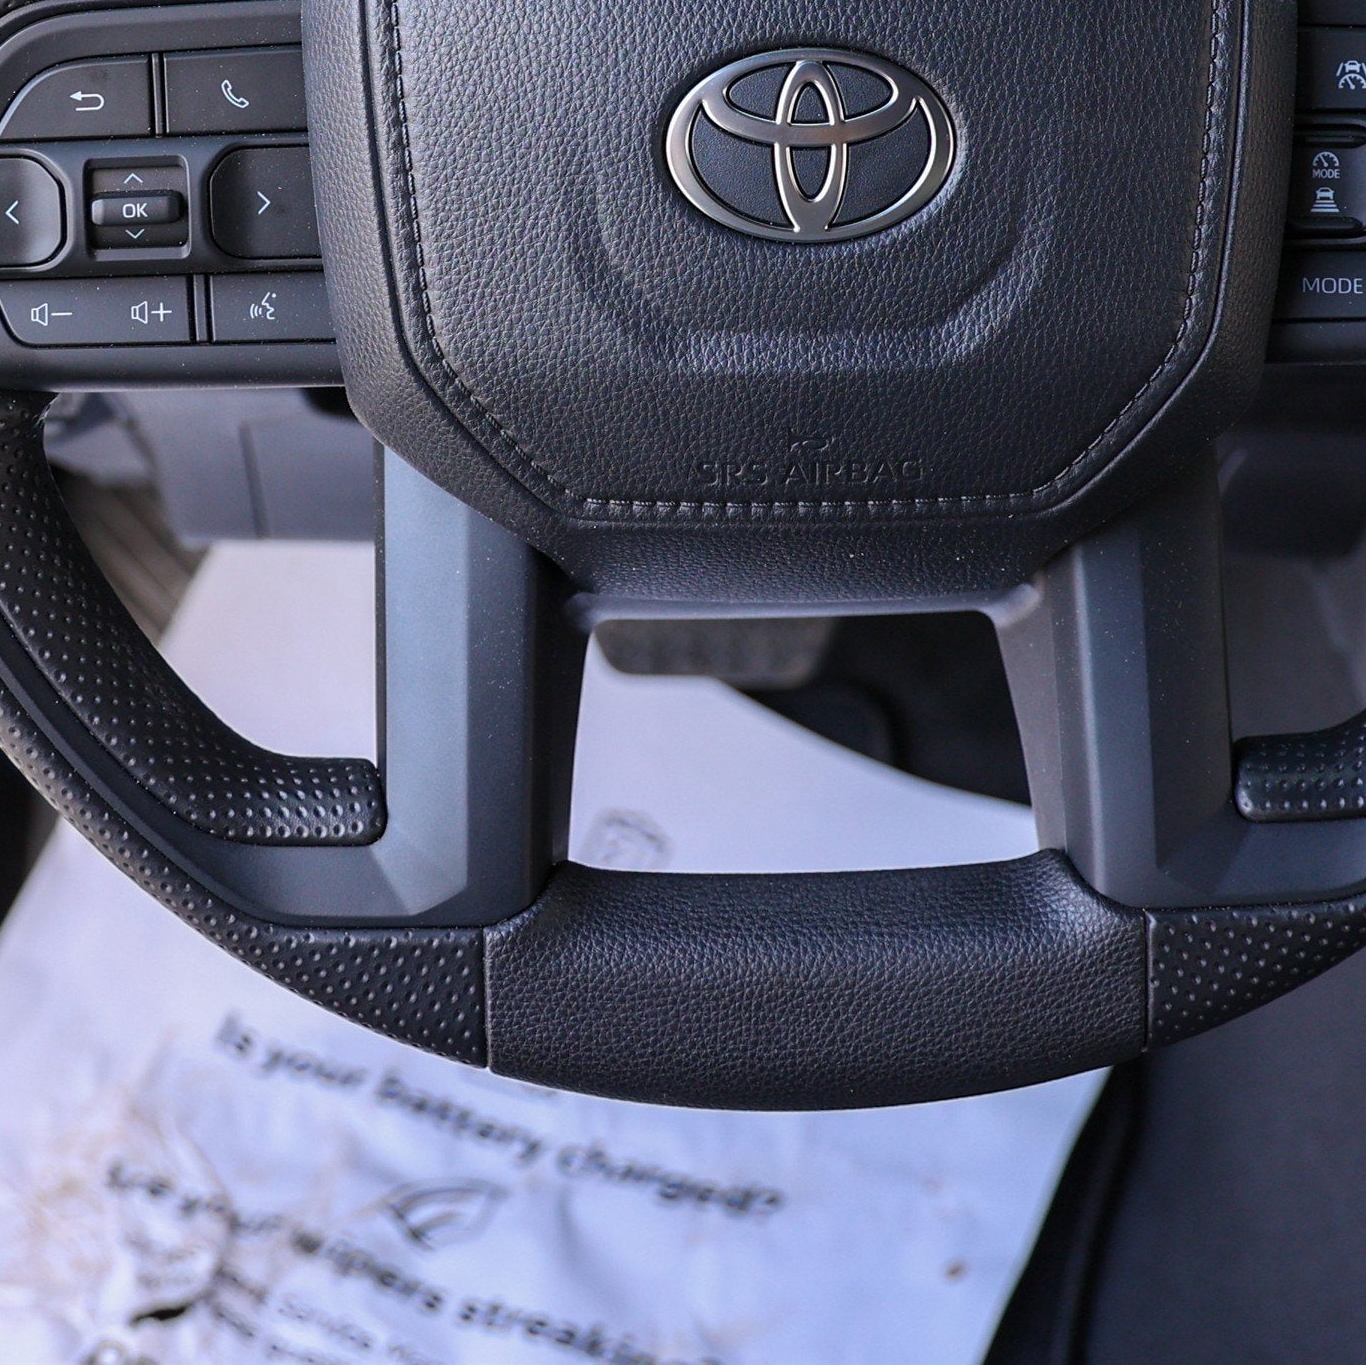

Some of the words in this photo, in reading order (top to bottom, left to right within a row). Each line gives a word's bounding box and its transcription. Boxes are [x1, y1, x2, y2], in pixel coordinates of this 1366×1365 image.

[1312, 168, 1340, 179] MODE
[122, 203, 149, 218] OK
[1302, 276, 1364, 295] MODE
[698, 463, 769, 486] SRS
[786, 459, 924, 485] AIRBAG
[260, 1046, 369, 1089] your
[377, 1071, 544, 1167] battery
[557, 1142, 785, 1217] charged?
